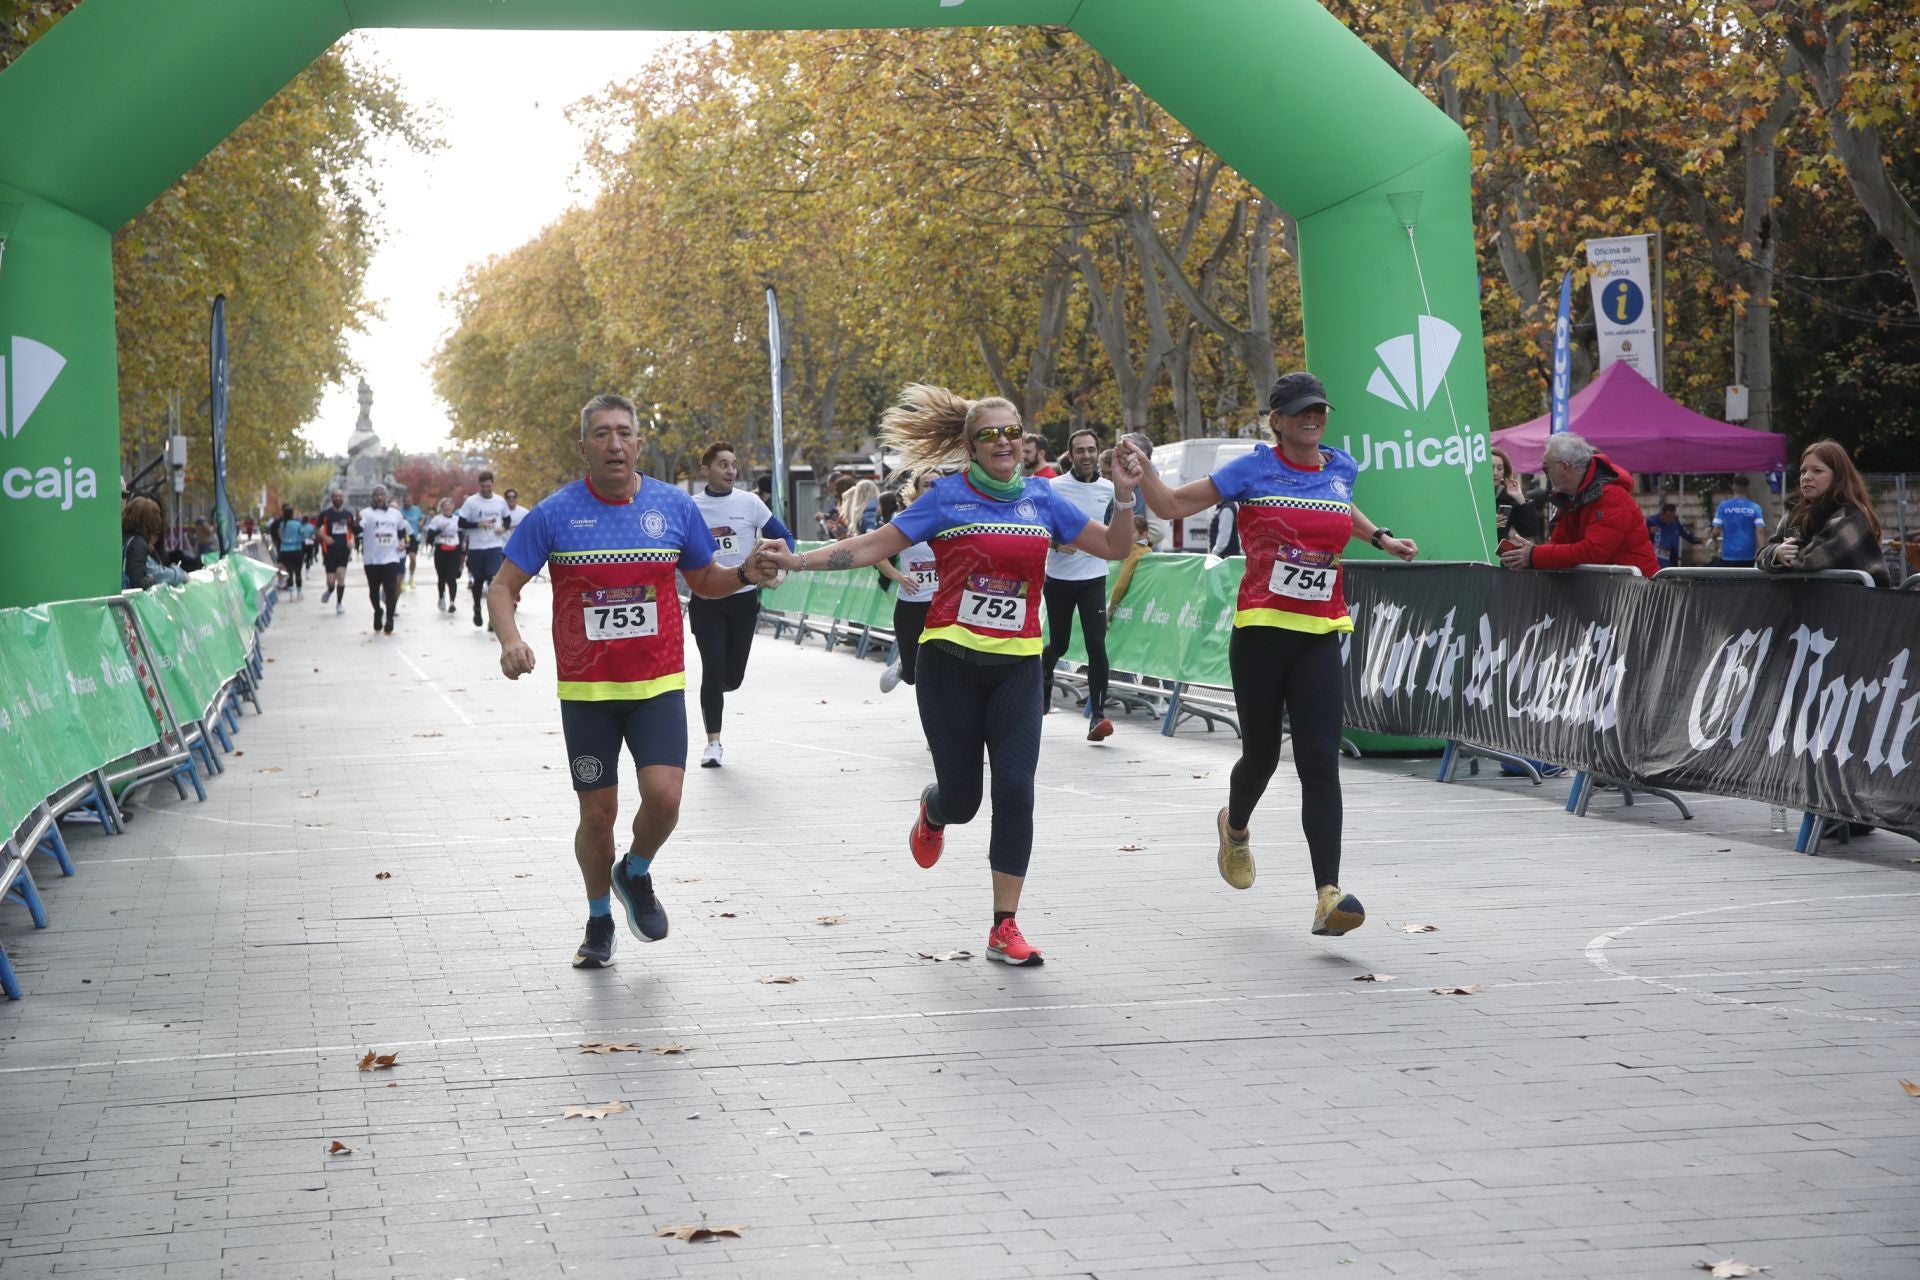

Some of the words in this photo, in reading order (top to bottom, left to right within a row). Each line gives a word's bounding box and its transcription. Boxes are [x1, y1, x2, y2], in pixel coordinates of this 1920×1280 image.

[1594, 247, 1620, 256] Oficina
[1621, 246, 1631, 254] de
[1343, 425, 1487, 476] Unicaja
[1283, 565, 1327, 591] 754
[594, 605, 646, 630] 753
[971, 594, 1017, 620] 752
[1361, 601, 1465, 701] Norte
[1688, 626, 1773, 751] El
[1767, 623, 1920, 778] Norte
